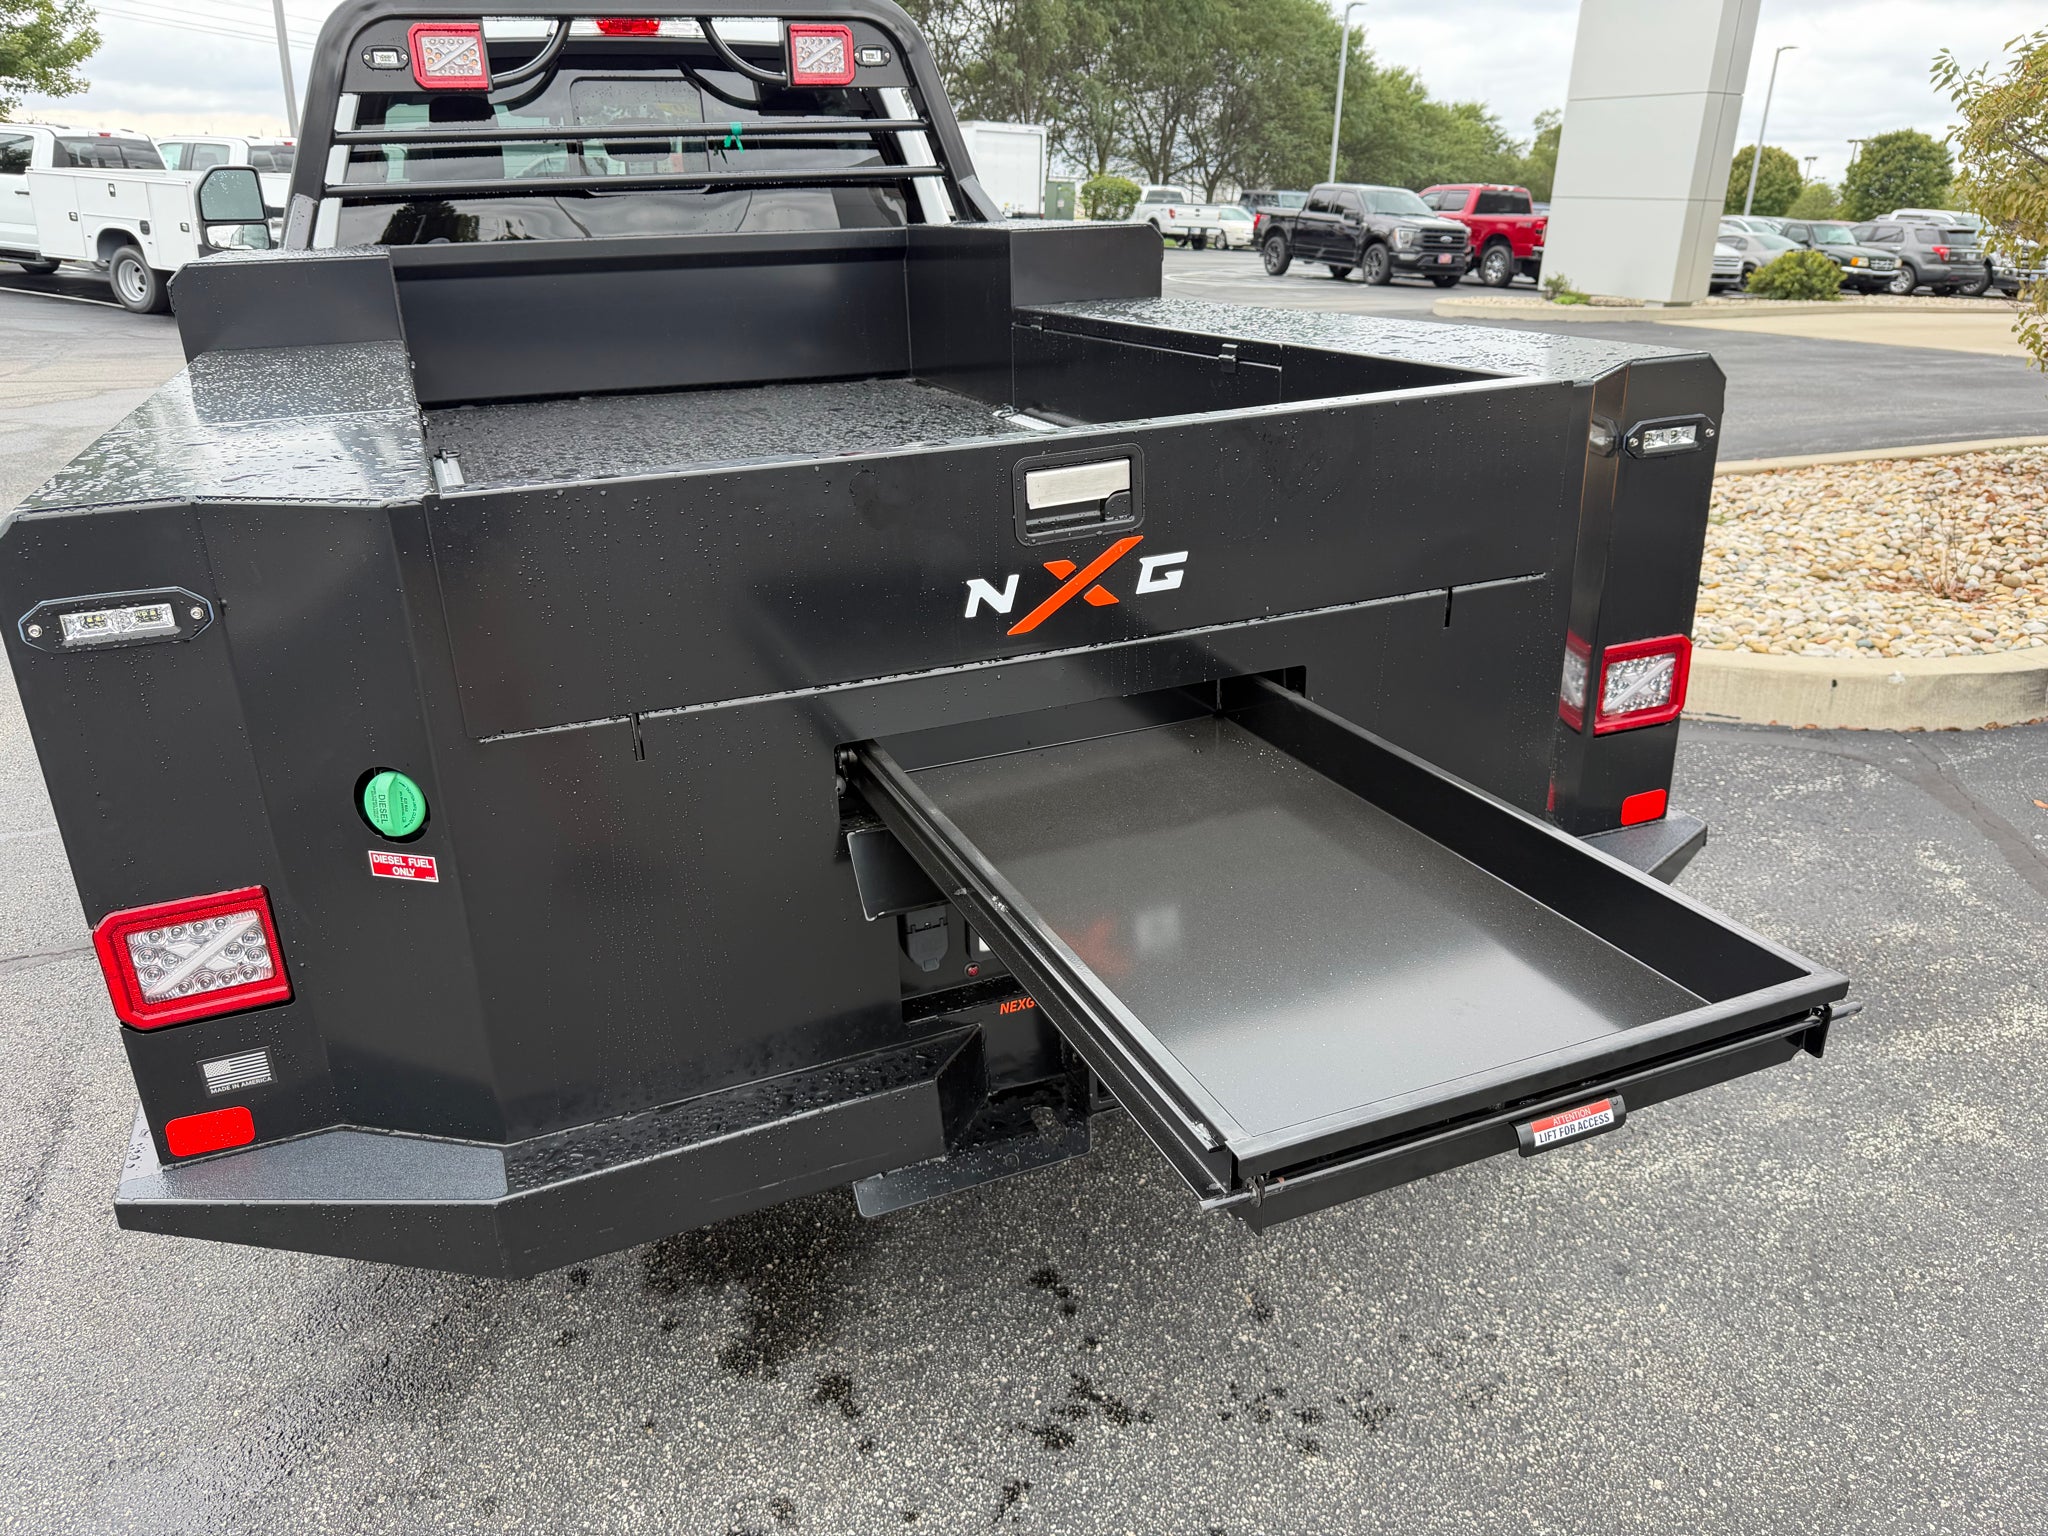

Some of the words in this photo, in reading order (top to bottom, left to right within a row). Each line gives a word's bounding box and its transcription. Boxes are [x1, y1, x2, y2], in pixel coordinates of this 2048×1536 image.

[378, 794, 389, 824] DIESEL
[373, 854, 406, 866] DIESEL
[408, 858, 432, 869] FUEL
[392, 866, 416, 877] ONLY
[1000, 997, 1036, 1015] NEXG
[210, 1084, 231, 1095] MADE
[241, 1076, 272, 1088] AMERICA
[1553, 1107, 1591, 1126] ATTENTION
[1539, 1129, 1557, 1143] LIFT
[1559, 1123, 1576, 1137] FOR
[1578, 1113, 1610, 1131] ACCESS
